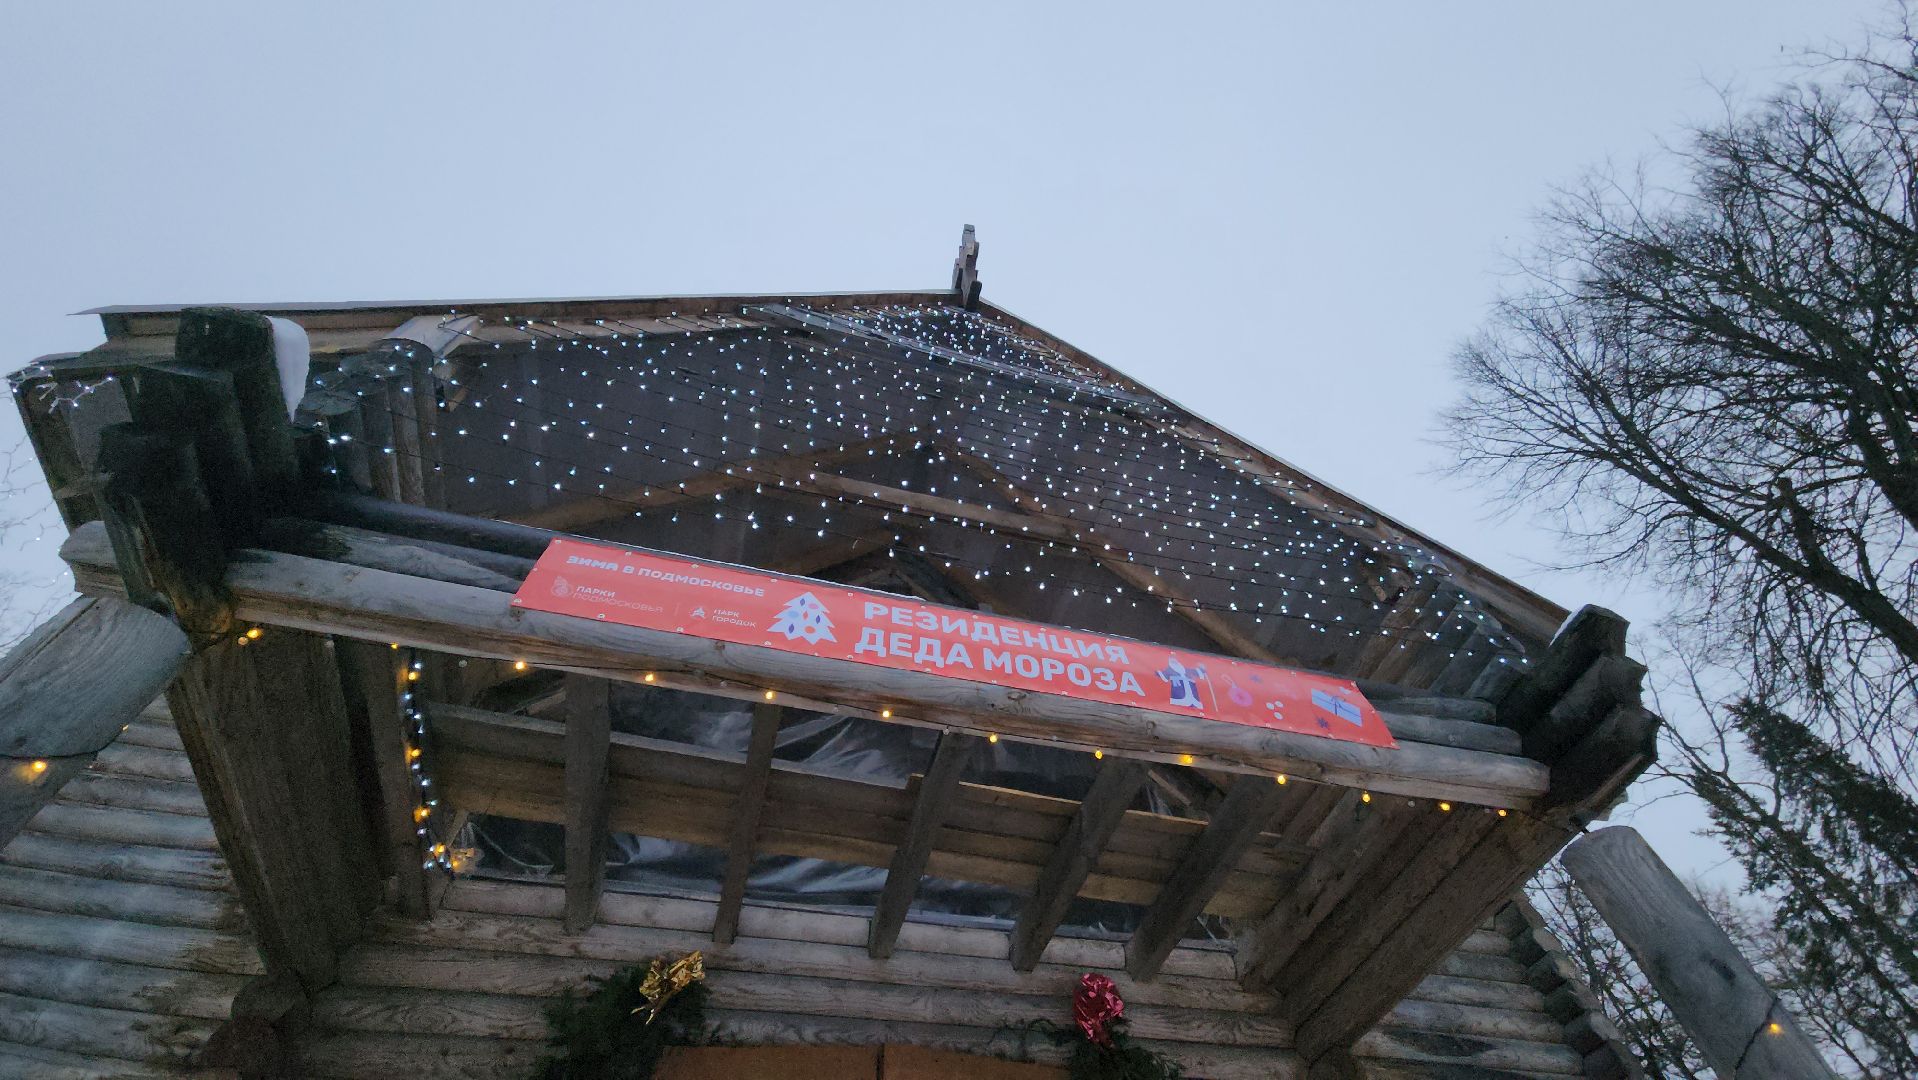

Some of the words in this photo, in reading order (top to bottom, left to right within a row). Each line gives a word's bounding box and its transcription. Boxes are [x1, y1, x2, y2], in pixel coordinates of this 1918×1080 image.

[566, 555, 619, 572] ЗИМА
[622, 565, 634, 574] В
[637, 568, 766, 597] ПОДМОСКОВЬЕ
[576, 585, 616, 598] ПАРКИ
[572, 592, 664, 613] ПОДМОСКОВЬЯ
[712, 615, 757, 628] ГОРОДОК
[713, 609, 740, 618] ПАРК
[864, 601, 1131, 665] РЕЗИДЕНЦИЯ
[854, 626, 975, 669] ДЕДА
[983, 647, 1146, 697] МОРОЗА
